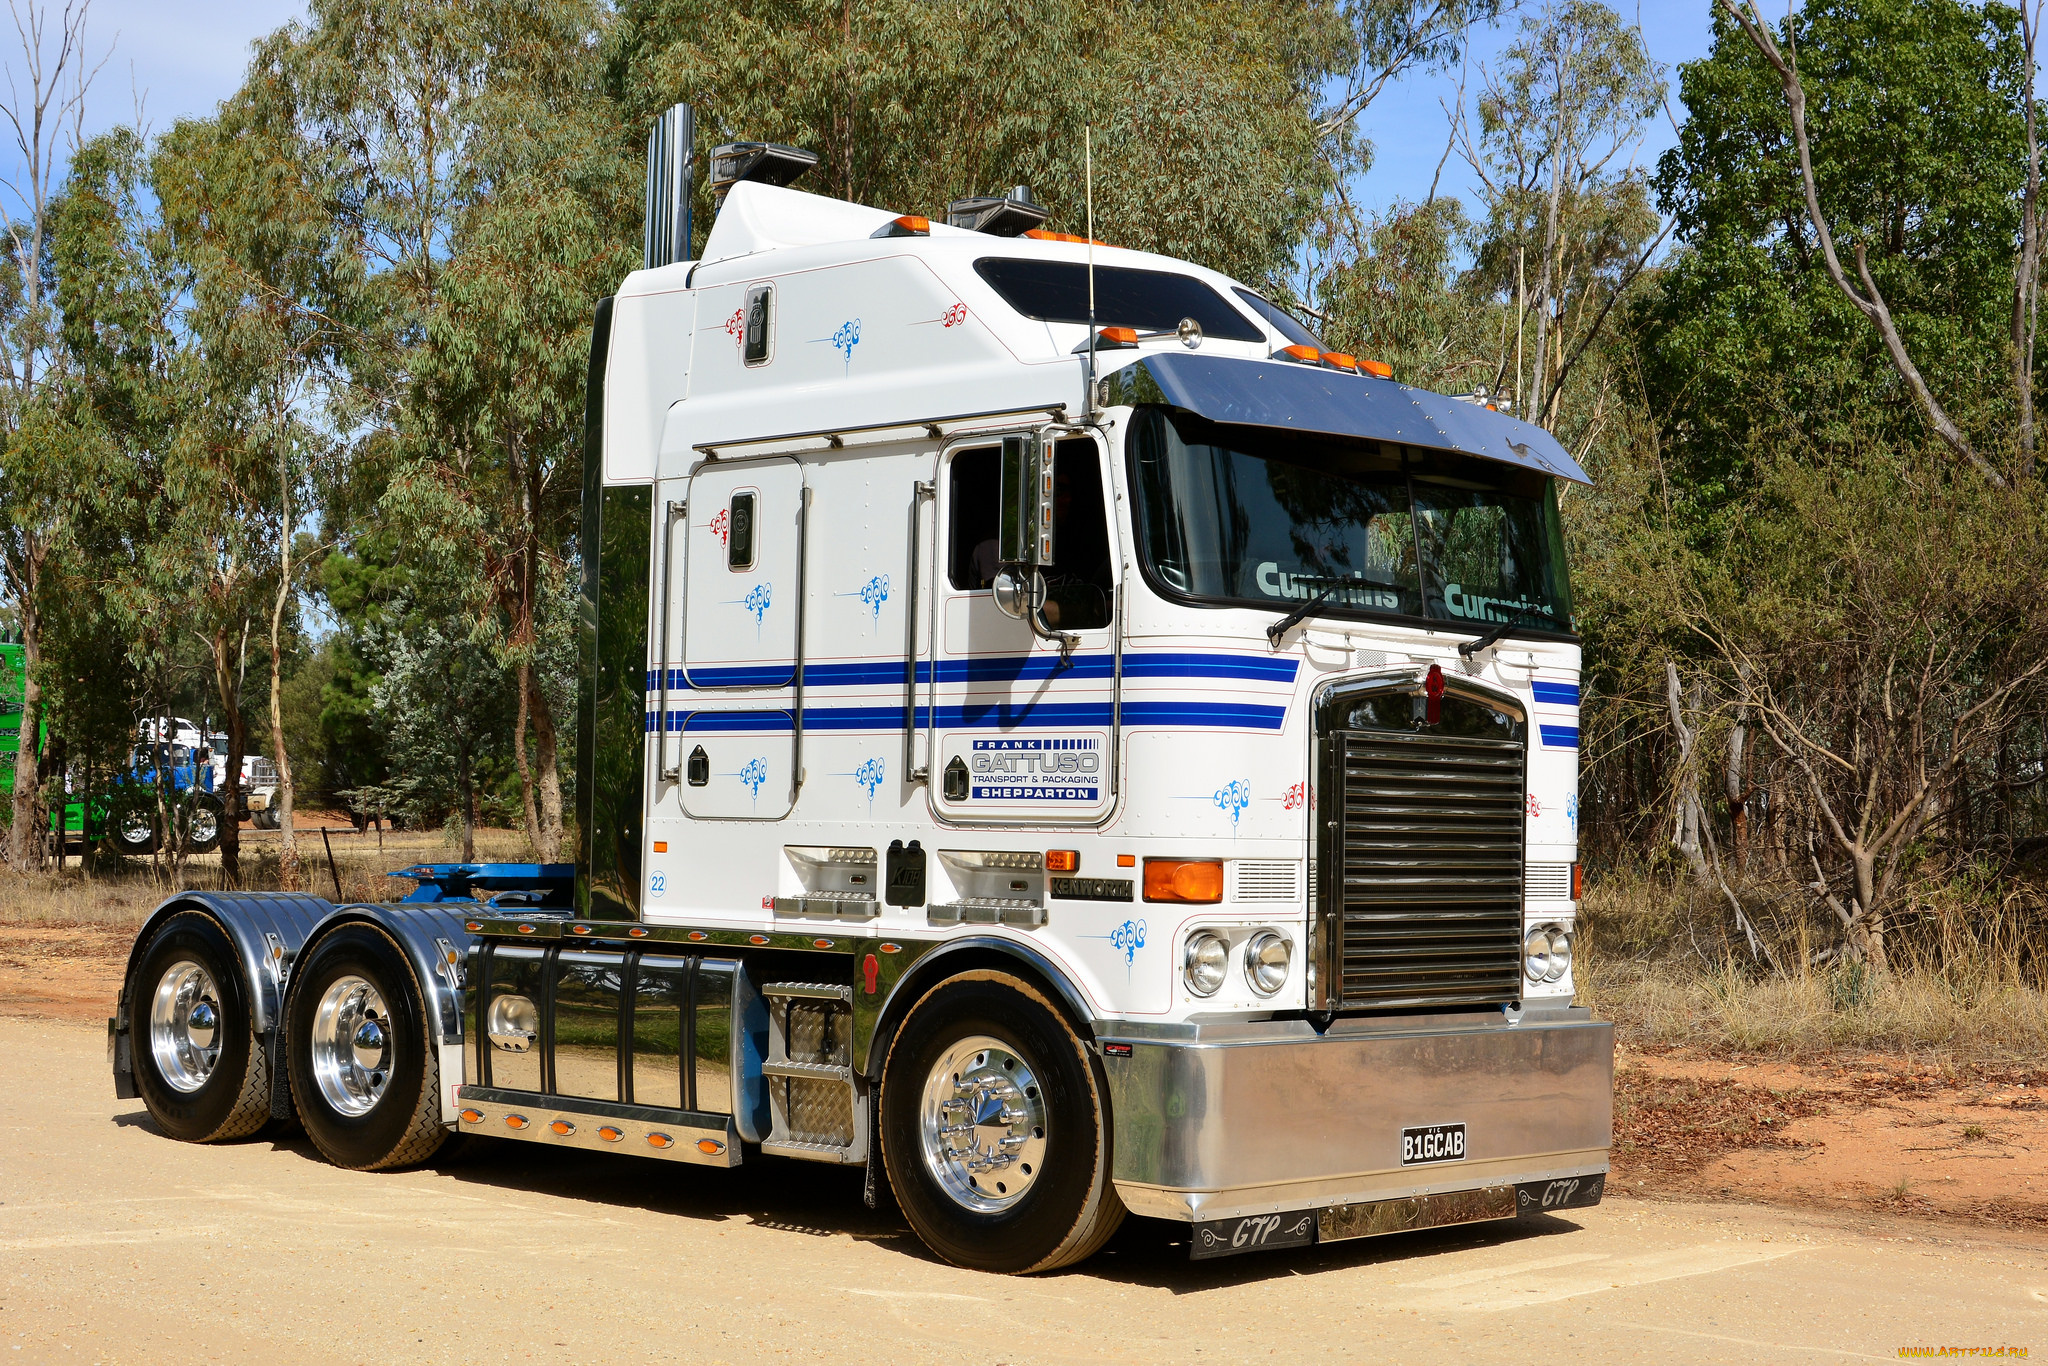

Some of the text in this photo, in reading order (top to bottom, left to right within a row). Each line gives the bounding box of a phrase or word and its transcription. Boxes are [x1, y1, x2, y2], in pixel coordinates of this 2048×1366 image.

[977, 741, 1035, 749] FRANK
[972, 753, 1099, 773] GATTUSO
[1043, 776, 1098, 784] PACKAGING
[981, 788, 1089, 799] SHEPPARTON
[652, 876, 664, 891] 22
[1052, 879, 1131, 897] KENWORTH
[1404, 1131, 1464, 1160] B1GCAB
[1541, 1179, 1579, 1207] GTP
[1232, 1215, 1281, 1248] GTP
